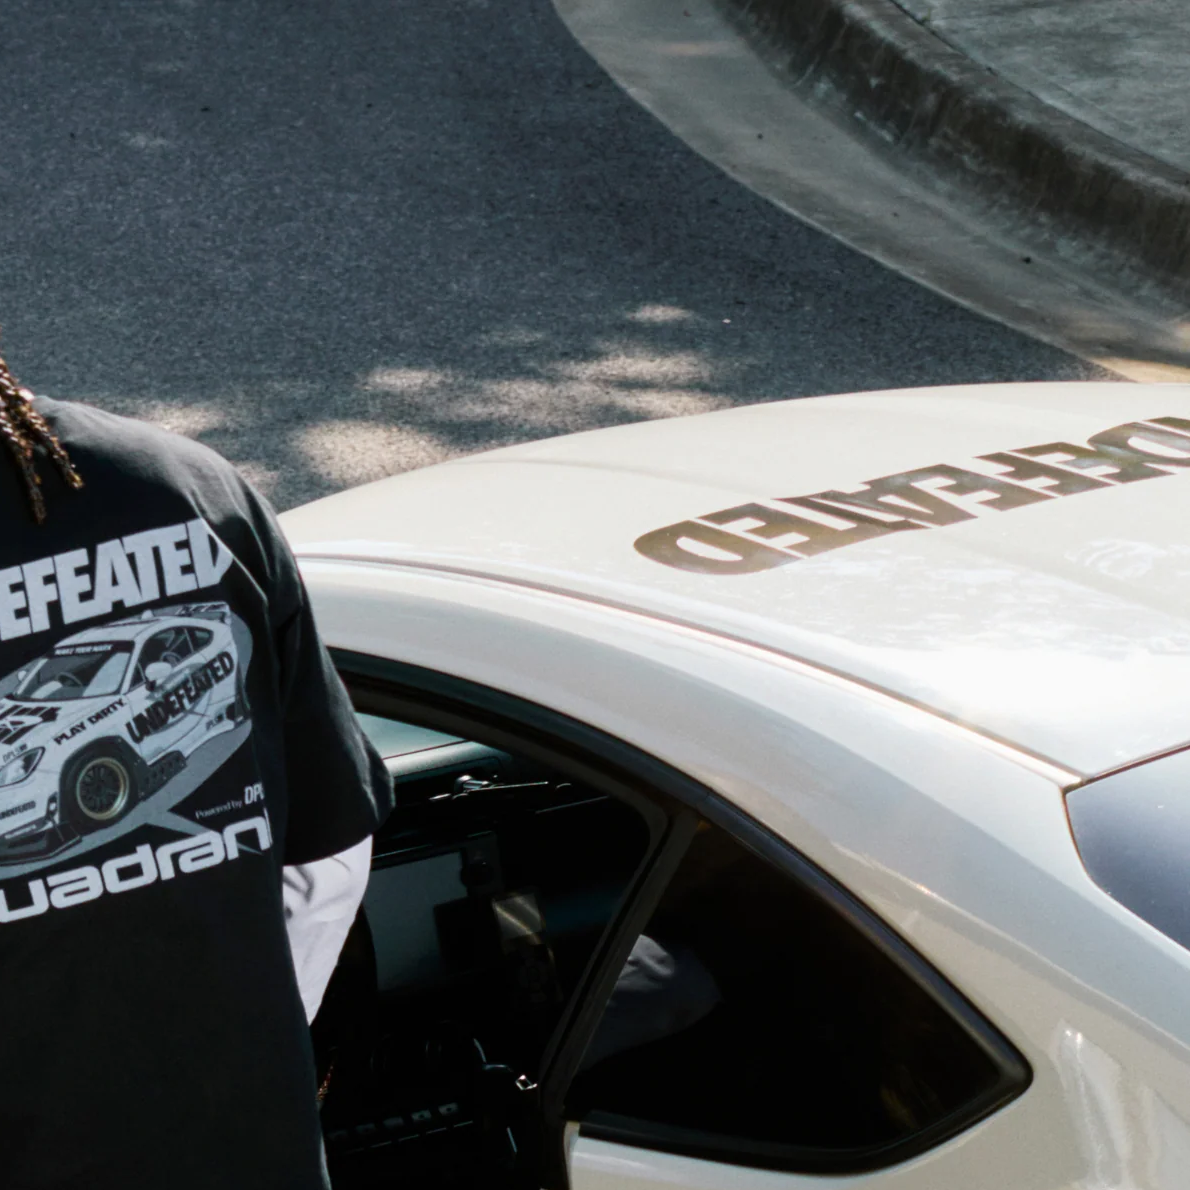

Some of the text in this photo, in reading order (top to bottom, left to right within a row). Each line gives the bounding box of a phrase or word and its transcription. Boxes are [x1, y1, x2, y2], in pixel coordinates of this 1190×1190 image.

[633, 416, 1190, 575] DEFEATED
[53, 722, 87, 746] PLAY
[125, 651, 235, 744] UNDEFEATED
